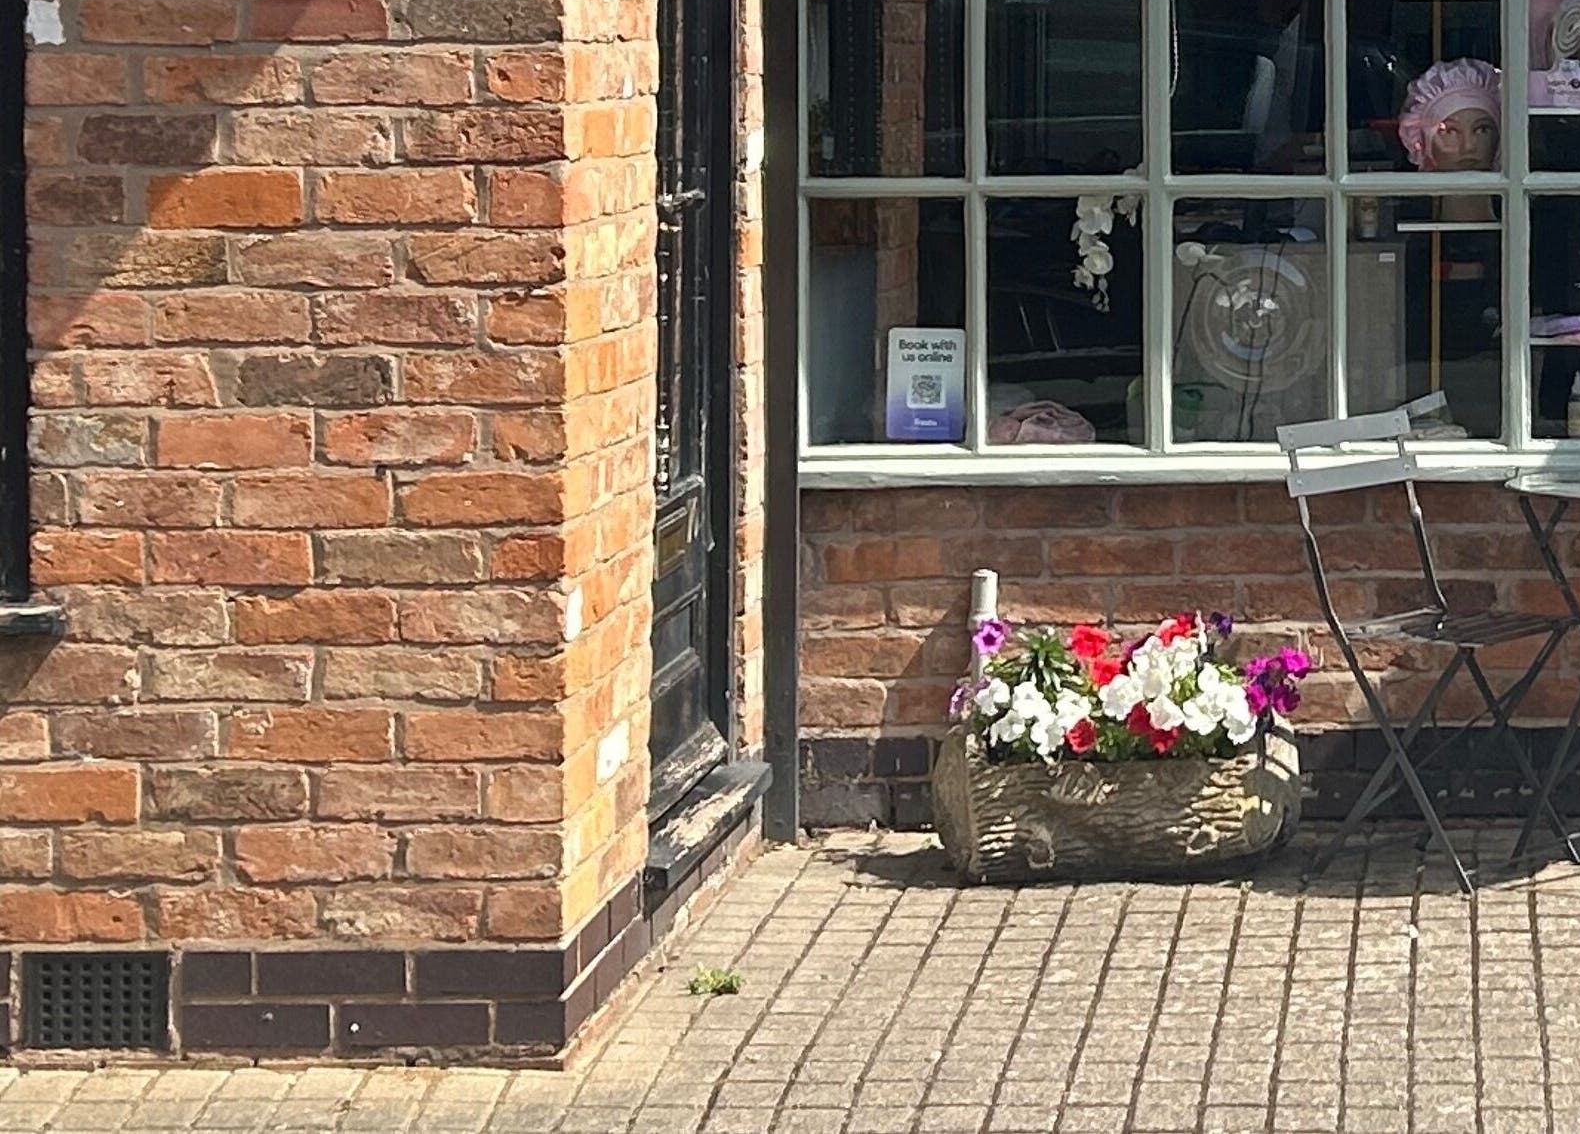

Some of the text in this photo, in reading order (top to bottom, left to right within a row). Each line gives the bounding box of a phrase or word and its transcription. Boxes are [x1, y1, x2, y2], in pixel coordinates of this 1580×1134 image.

[898, 339, 957, 351] Book with
[902, 351, 954, 363] us online
